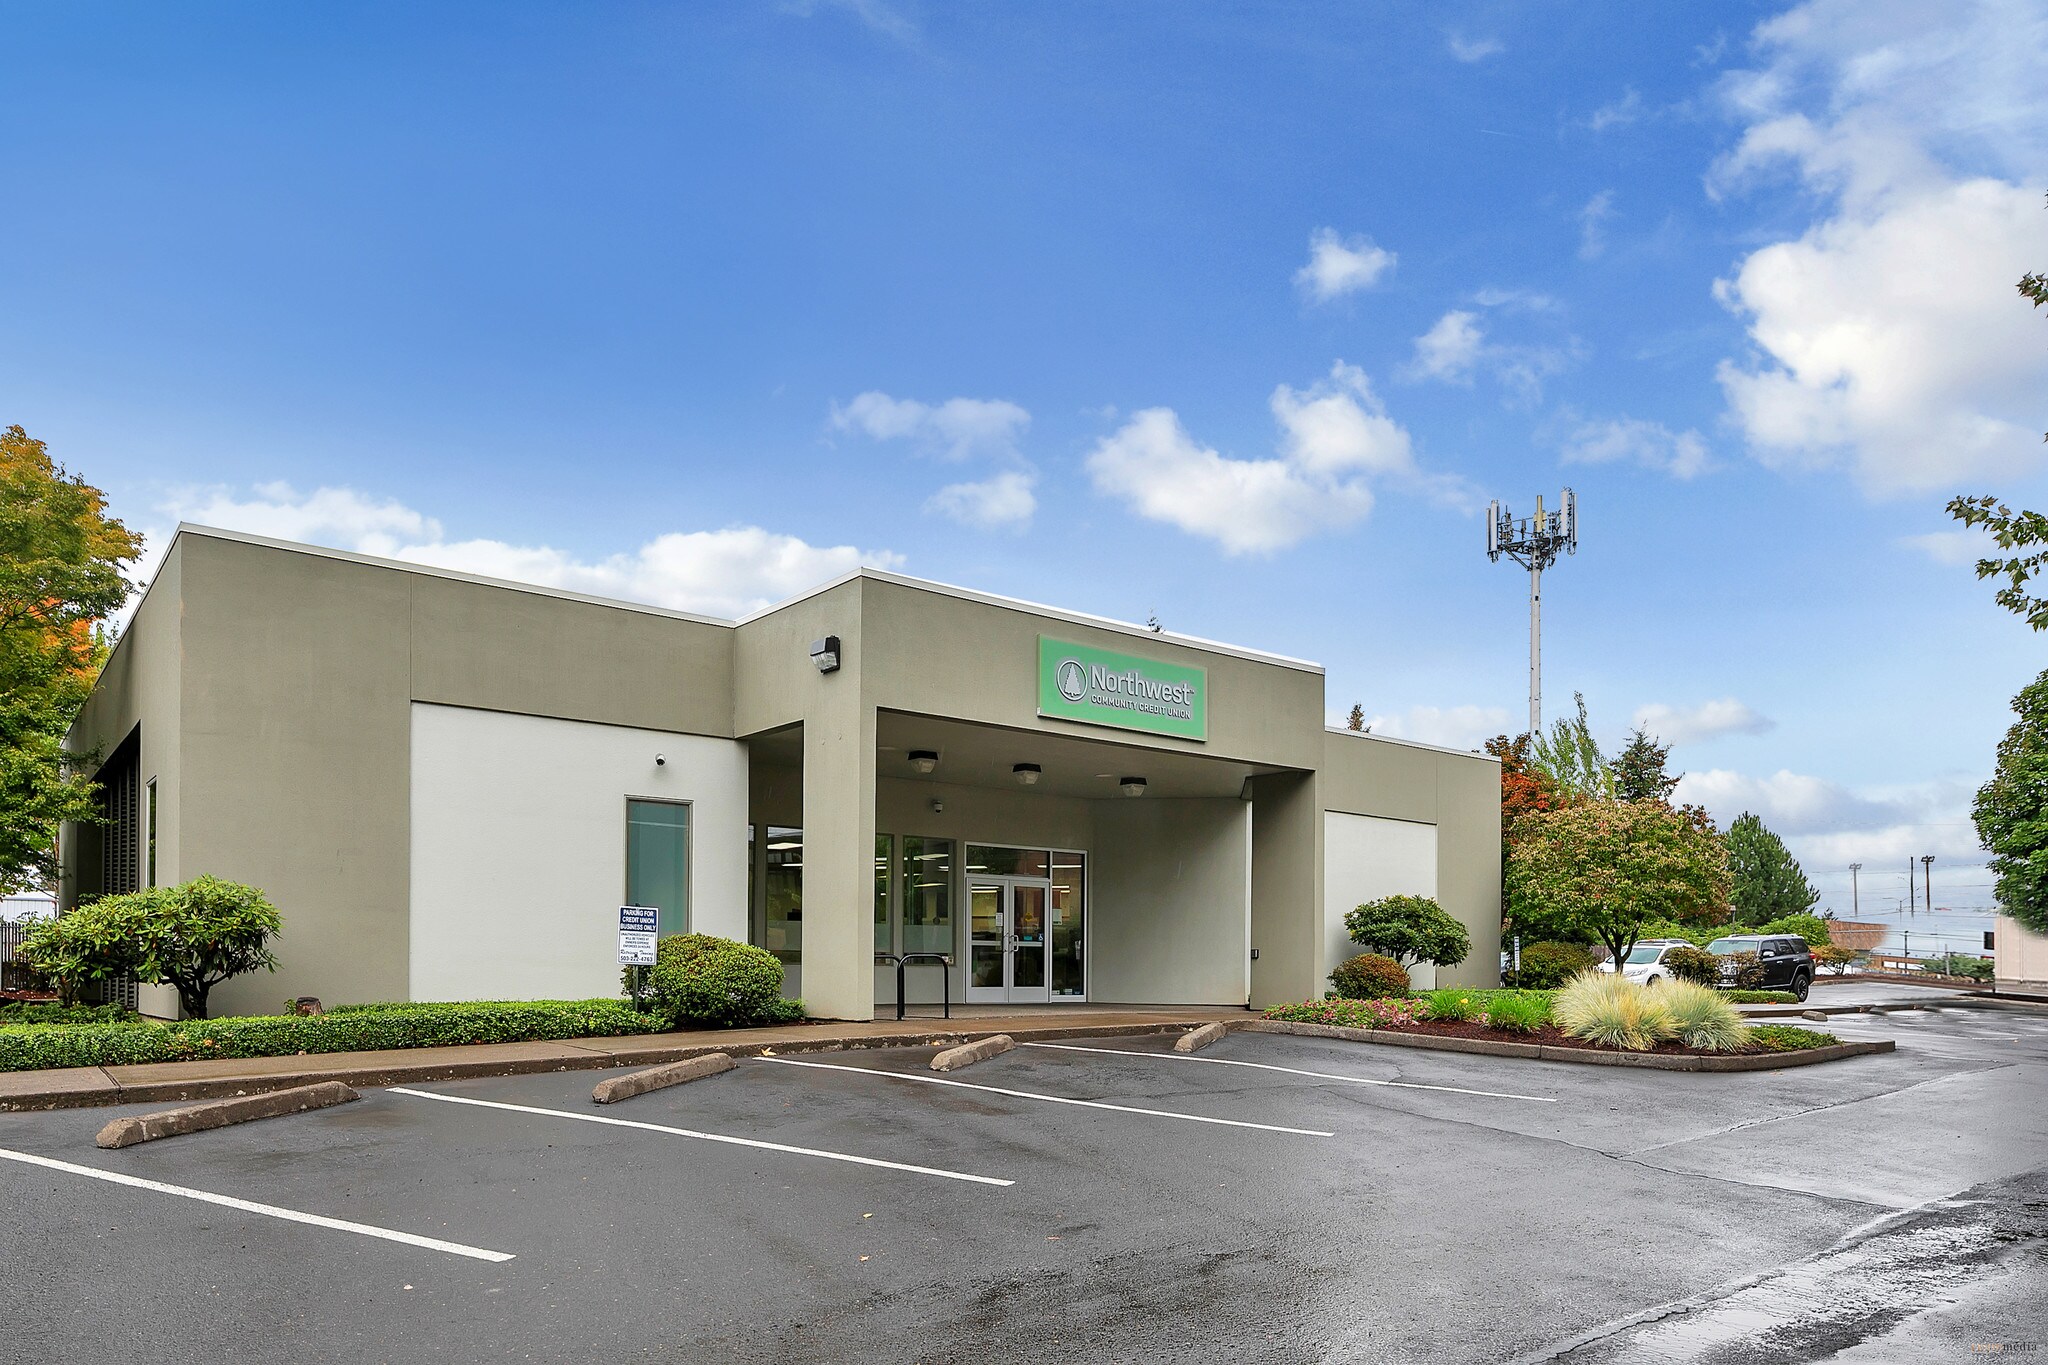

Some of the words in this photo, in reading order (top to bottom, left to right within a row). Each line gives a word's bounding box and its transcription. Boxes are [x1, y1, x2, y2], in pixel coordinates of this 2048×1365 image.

[1090, 664, 1191, 705] Northwest
[1091, 694, 1137, 711] COMMUNITY
[1138, 702, 1166, 715] CREDIT
[1167, 708, 1191, 720] UNION
